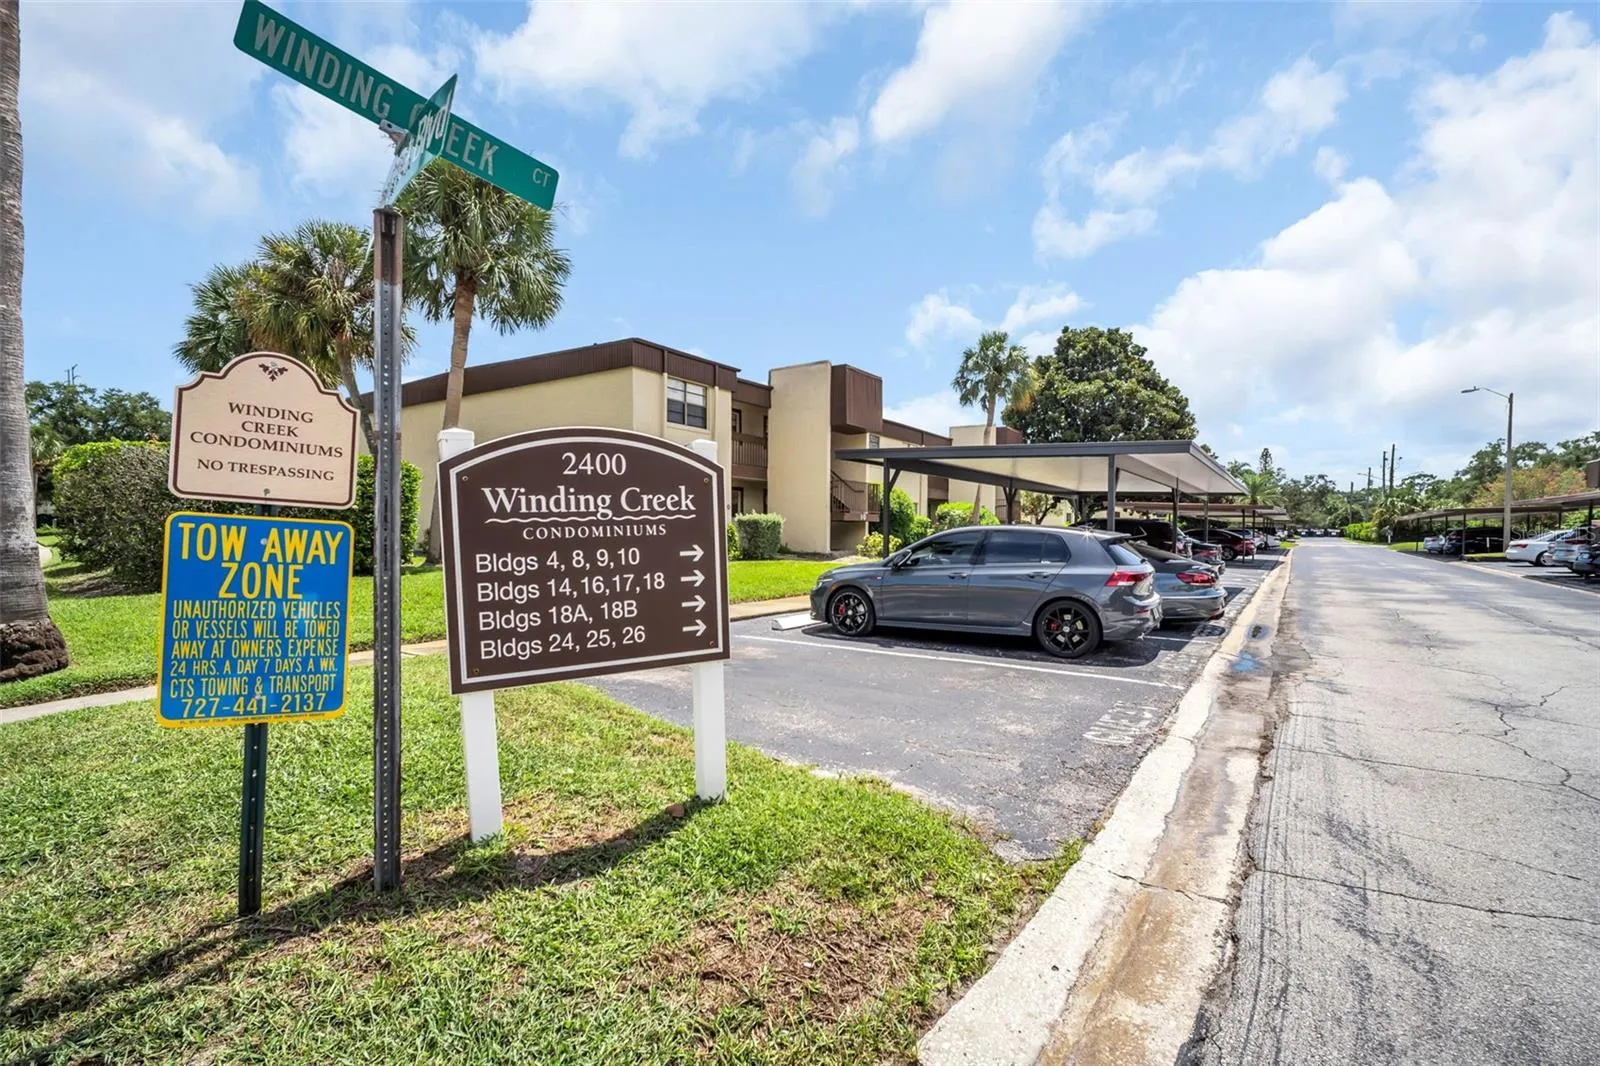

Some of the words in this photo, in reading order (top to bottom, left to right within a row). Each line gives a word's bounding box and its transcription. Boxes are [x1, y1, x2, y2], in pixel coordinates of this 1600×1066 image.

[254, 13, 394, 118] WINDING
[409, 103, 499, 176] CEEK
[532, 168, 551, 188] CT
[228, 402, 314, 424] WINDING
[241, 420, 300, 437] CREEK
[190, 431, 343, 458] CONDOMINIUMS
[197, 459, 223, 471] NO
[227, 461, 335, 481] TRESPASSING
[561, 452, 627, 476] 2400
[481, 485, 612, 521] Winding
[619, 485, 696, 512] Creek
[178, 522, 247, 562] TOW
[262, 527, 343, 565] AWAY
[522, 523, 667, 540] CONDOMINIUMS
[475, 552, 539, 576] Bldgs
[546, 551, 565, 572] 4,
[571, 550, 590, 571] 8,
[218, 562, 304, 599] ZONE
[477, 581, 540, 604] Bldgs
[173, 600, 276, 619] UNAUTHORIZED
[282, 601, 341, 619] VEHICLES
[479, 609, 541, 632] Bldgs
[548, 604, 593, 625] 18A,
[600, 600, 638, 620] 18B
[172, 620, 189, 639] OR
[195, 620, 247, 639] VESSELS
[253, 621, 279, 639] WILL
[285, 621, 299, 638] BE
[304, 620, 340, 638] TOWED
[171, 640, 206, 659] AWAY
[211, 640, 226, 659] AT
[231, 639, 282, 658] OWNERS
[288, 639, 338, 657] EXPENSE
[480, 638, 542, 660] Bldgs
[548, 632, 581, 653] 24,
[586, 628, 617, 649] 25,
[622, 625, 646, 645] 26
[170, 660, 186, 676] 24
[193, 660, 219, 675] HRS.
[223, 660, 231, 674] A
[237, 659, 259, 674] DAY
[264, 659, 270, 673] 7
[275, 658, 302, 673] DAYS
[307, 659, 315, 672] A
[319, 657, 338, 672] WK.
[170, 678, 195, 698] CTS
[201, 677, 249, 697] TOWING
[255, 677, 264, 696] &
[269, 674, 337, 694] TRANSPORT
[181, 693, 326, 718] 727-441-2137
